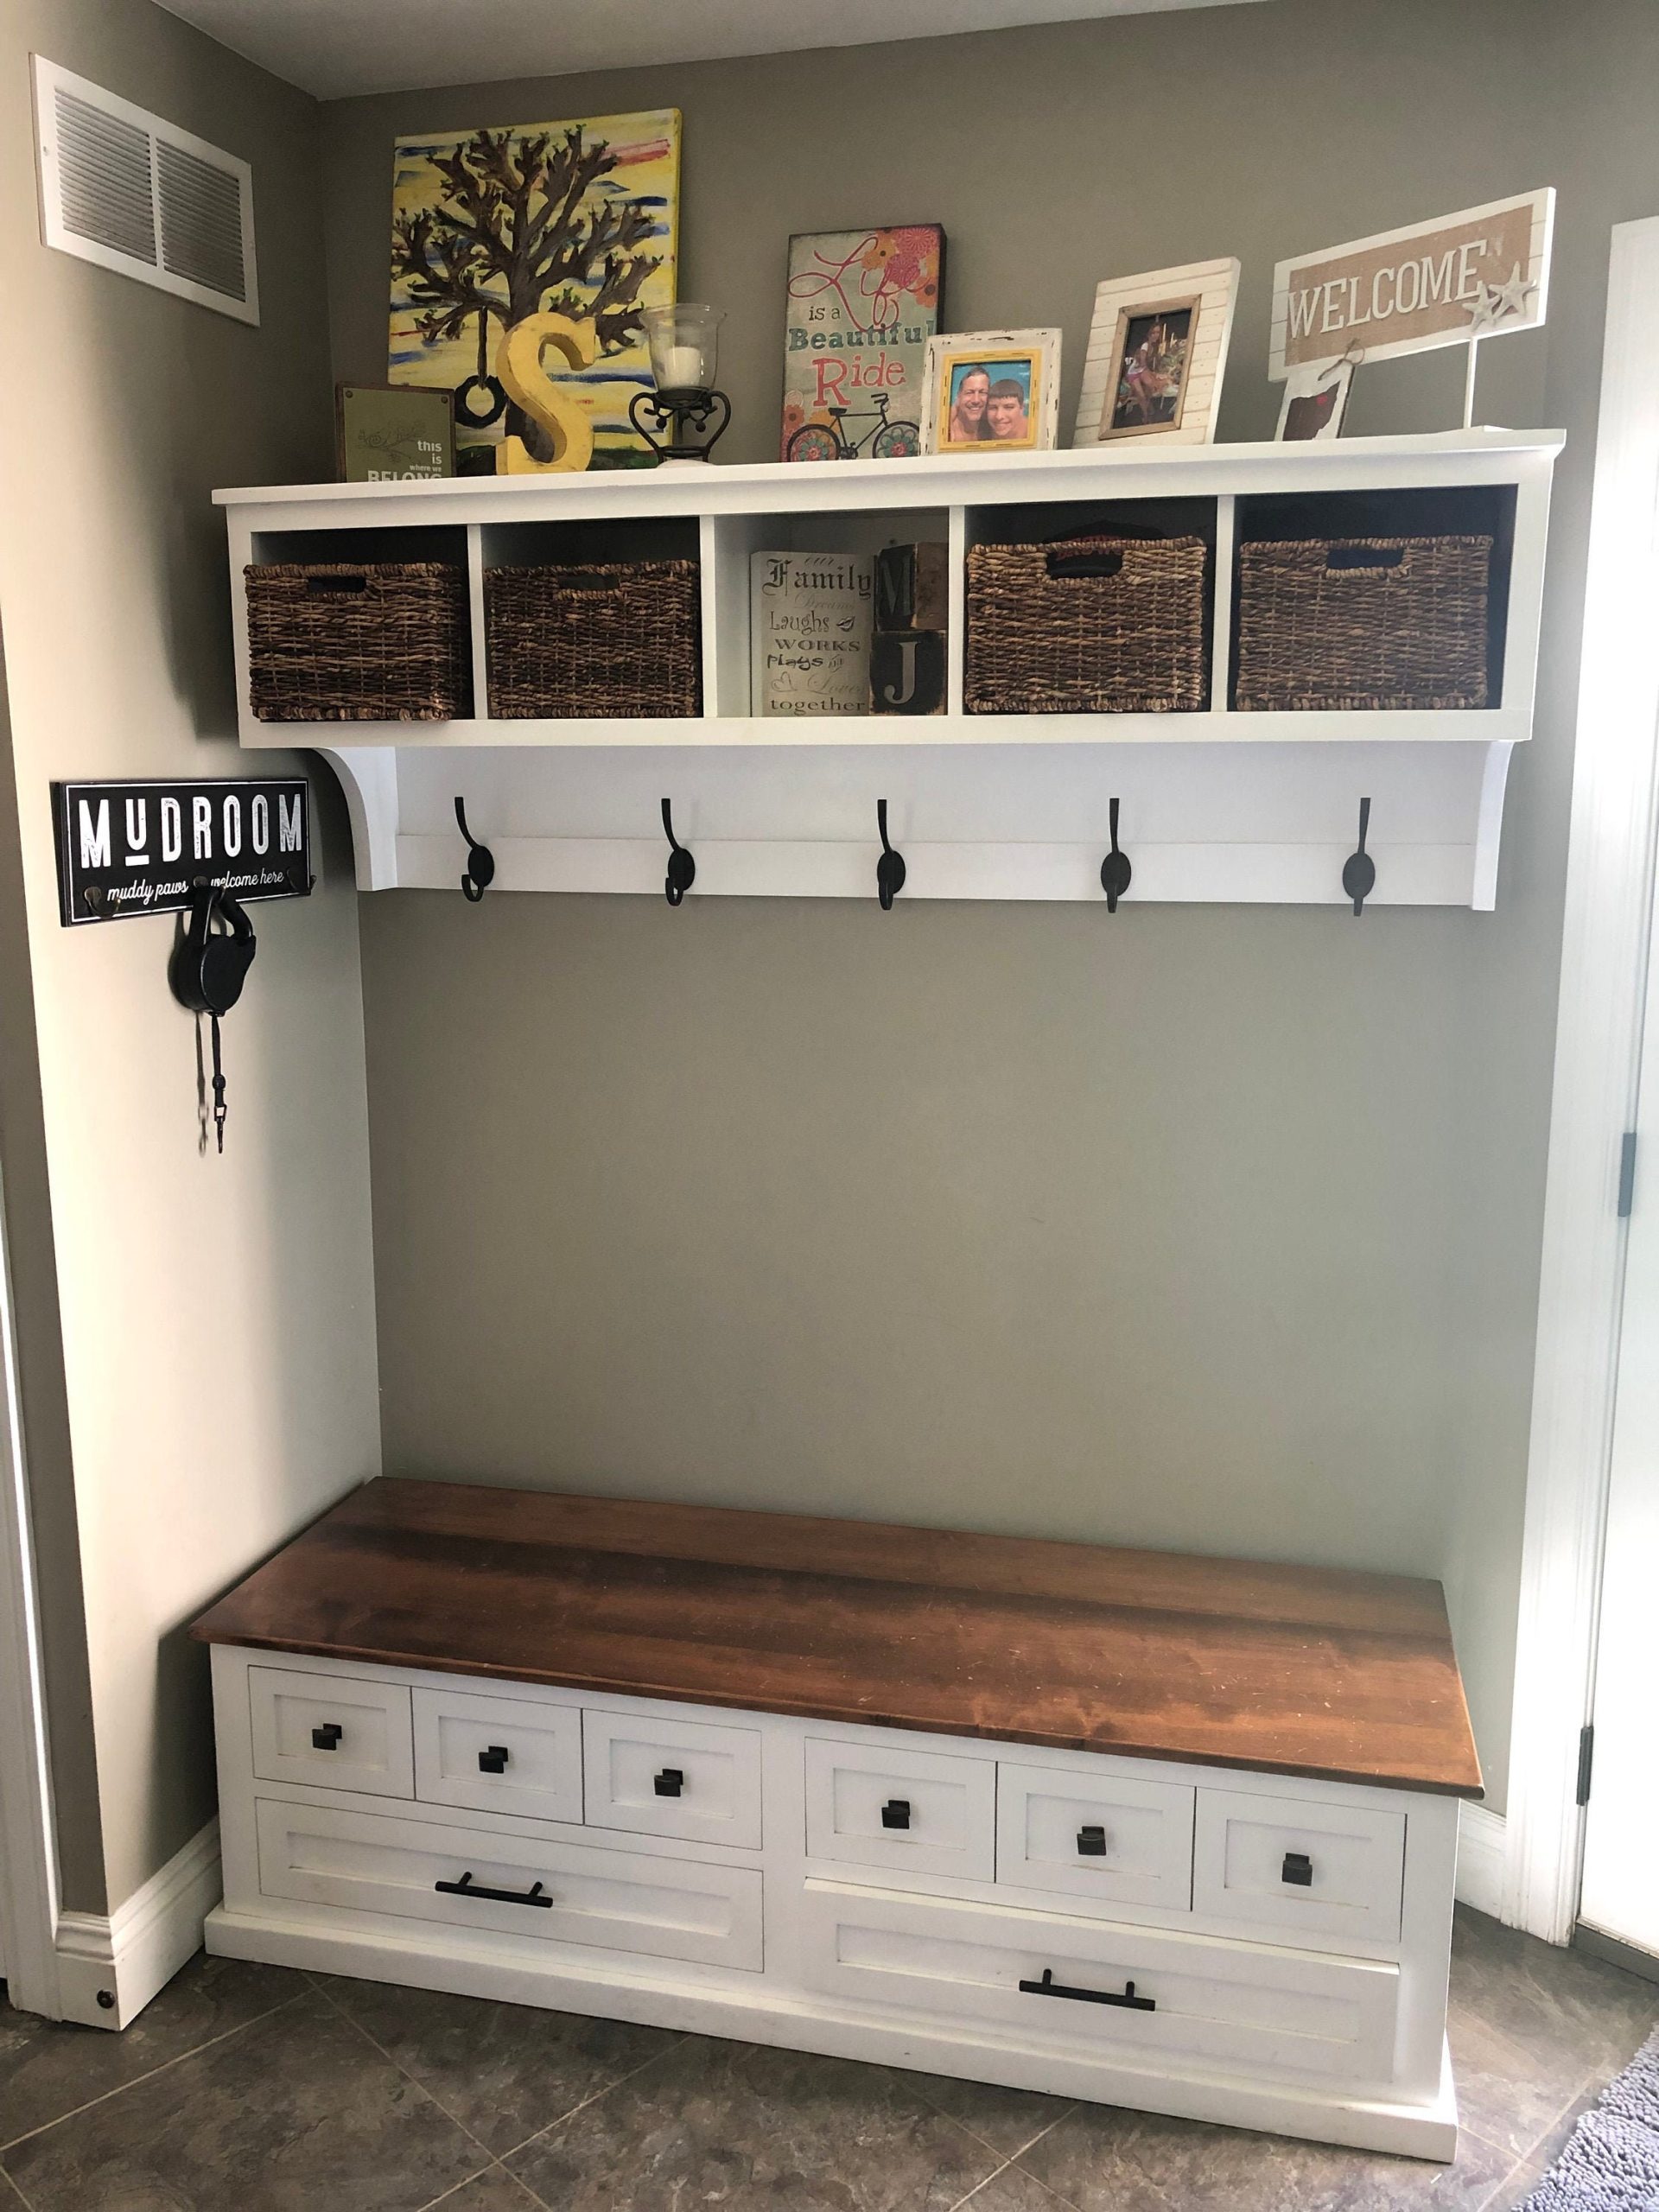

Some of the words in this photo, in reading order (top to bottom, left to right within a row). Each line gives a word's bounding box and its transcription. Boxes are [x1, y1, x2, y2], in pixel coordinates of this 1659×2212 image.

[1287, 238, 1488, 340] WELCOME
[809, 306, 825, 321] is
[830, 308, 841, 320] a
[788, 319, 934, 352] Beautiful
[495, 311, 597, 475] S
[811, 352, 906, 407] Ride
[417, 440, 442, 452] this
[431, 453, 442, 465] is
[367, 470, 442, 482] BELO
[761, 558, 871, 601] Family
[769, 609, 830, 635] Laughs
[774, 639, 861, 652] WORKS
[883, 640, 922, 705] J
[770, 696, 866, 716] together
[79, 793, 302, 868] MUDROOM
[106, 878, 155, 906] muddy
[154, 880, 189, 902] paws
[210, 870, 259, 888] welcome
[259, 867, 284, 885] here
